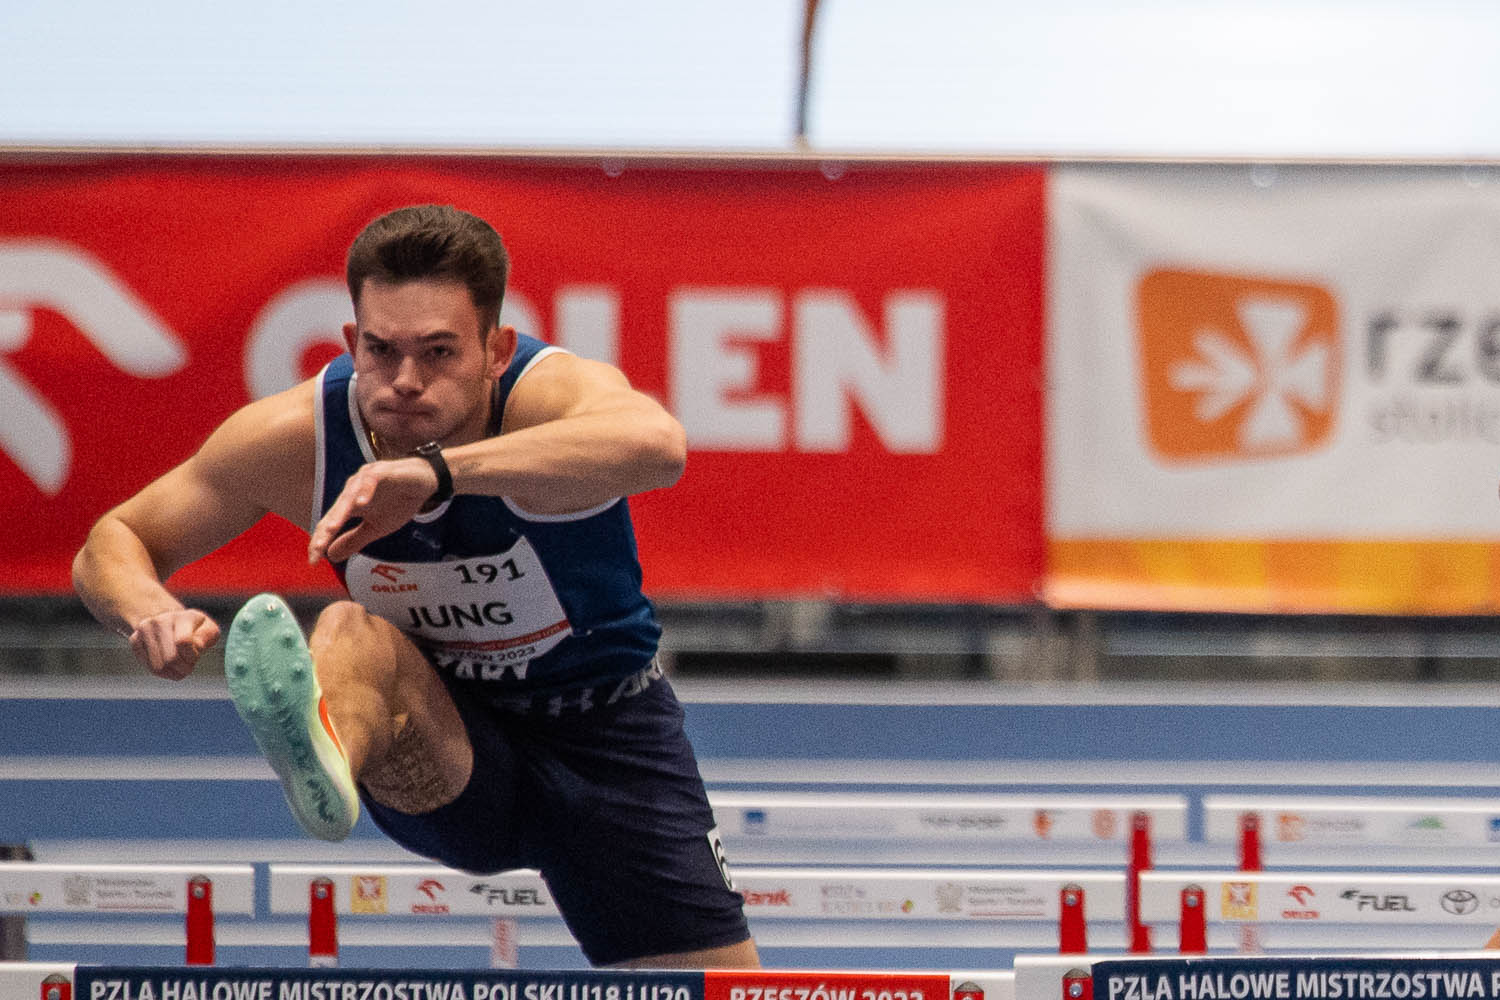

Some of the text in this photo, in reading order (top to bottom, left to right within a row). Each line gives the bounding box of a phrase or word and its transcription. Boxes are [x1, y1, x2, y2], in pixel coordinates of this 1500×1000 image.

[454, 559, 525, 585] 191
[371, 583, 418, 593] ORLEN
[408, 601, 514, 629] JUNG
[487, 888, 546, 906] FUEL
[1356, 895, 1417, 912] FUEL
[1179, 973, 1290, 1000] HALOWE
[1296, 972, 1485, 1000] MISTRZOSTWA
